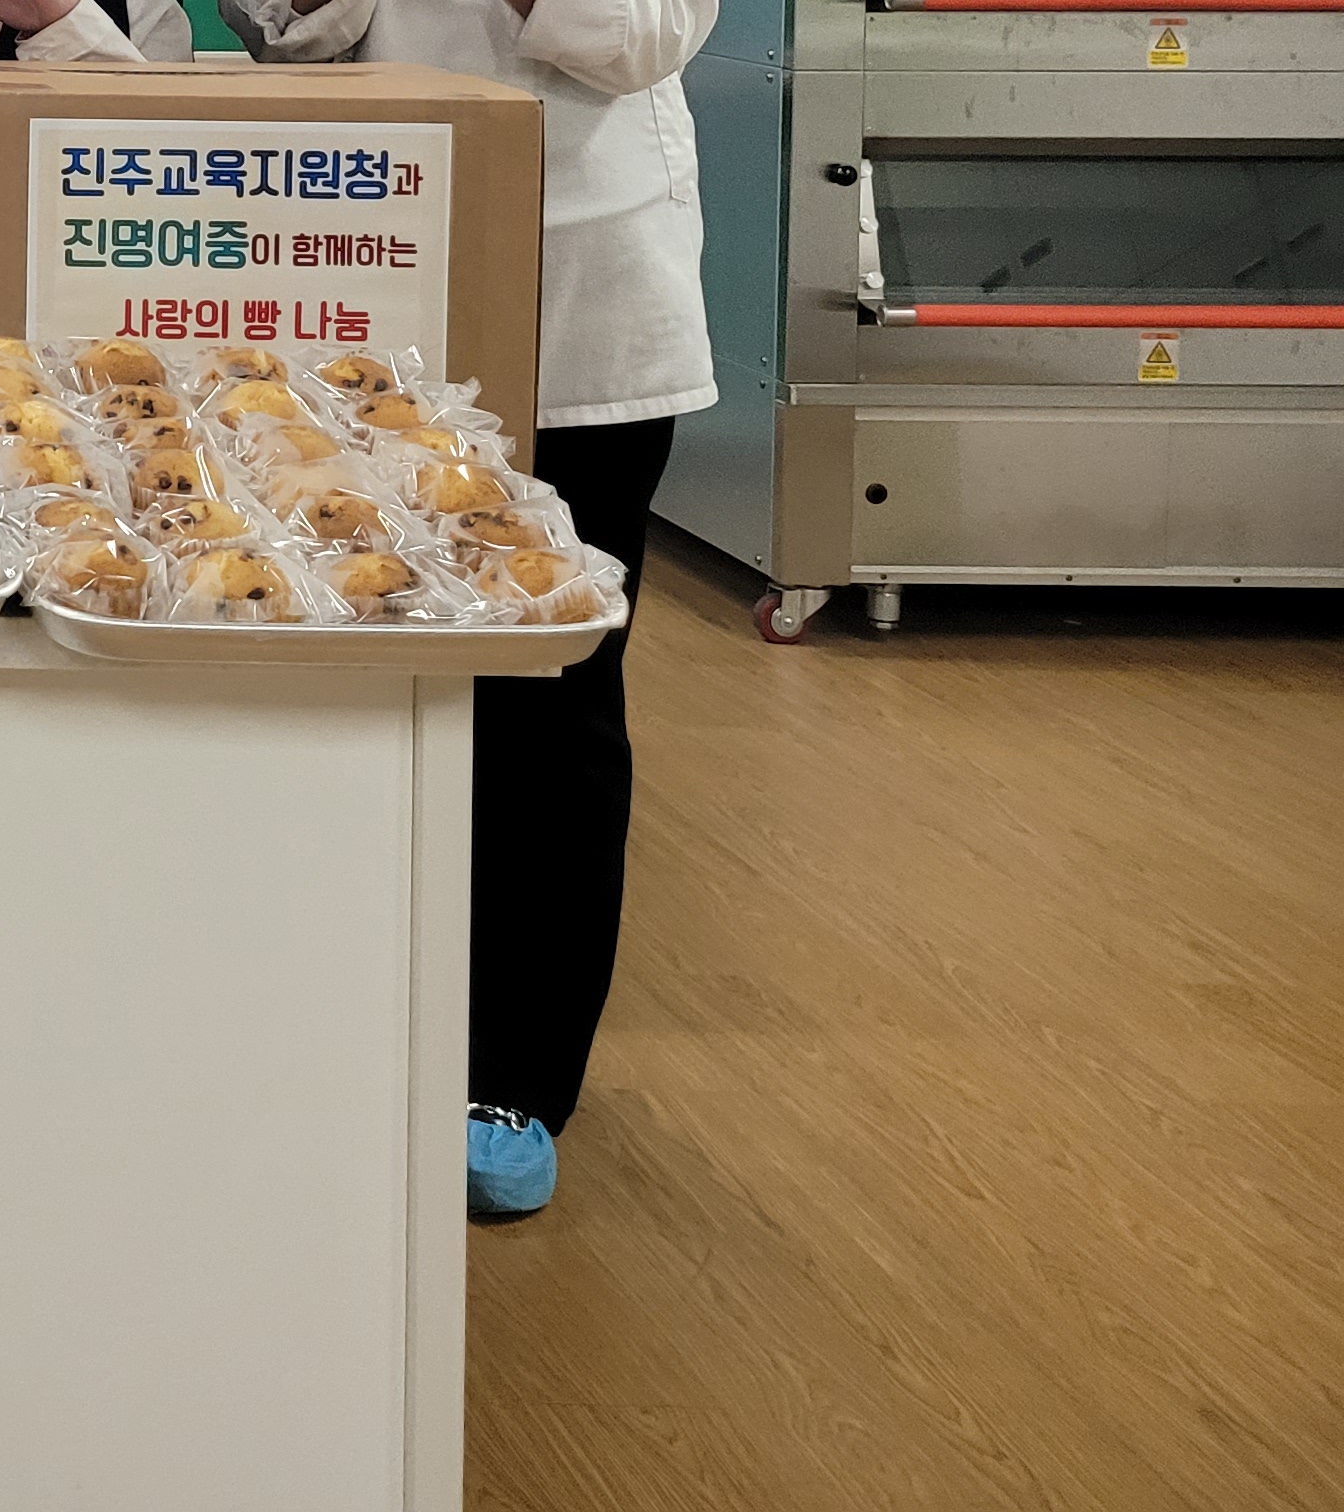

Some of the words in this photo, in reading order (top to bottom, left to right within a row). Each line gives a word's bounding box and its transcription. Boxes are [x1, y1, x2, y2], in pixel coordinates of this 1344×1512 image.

[61, 146, 424, 199] 진주교육지원청과
[63, 218, 280, 269] 진명여중이
[291, 233, 418, 268] 함께하는
[115, 298, 229, 340] 사랑의
[243, 299, 281, 341] 빵
[293, 300, 371, 342] 나눔
